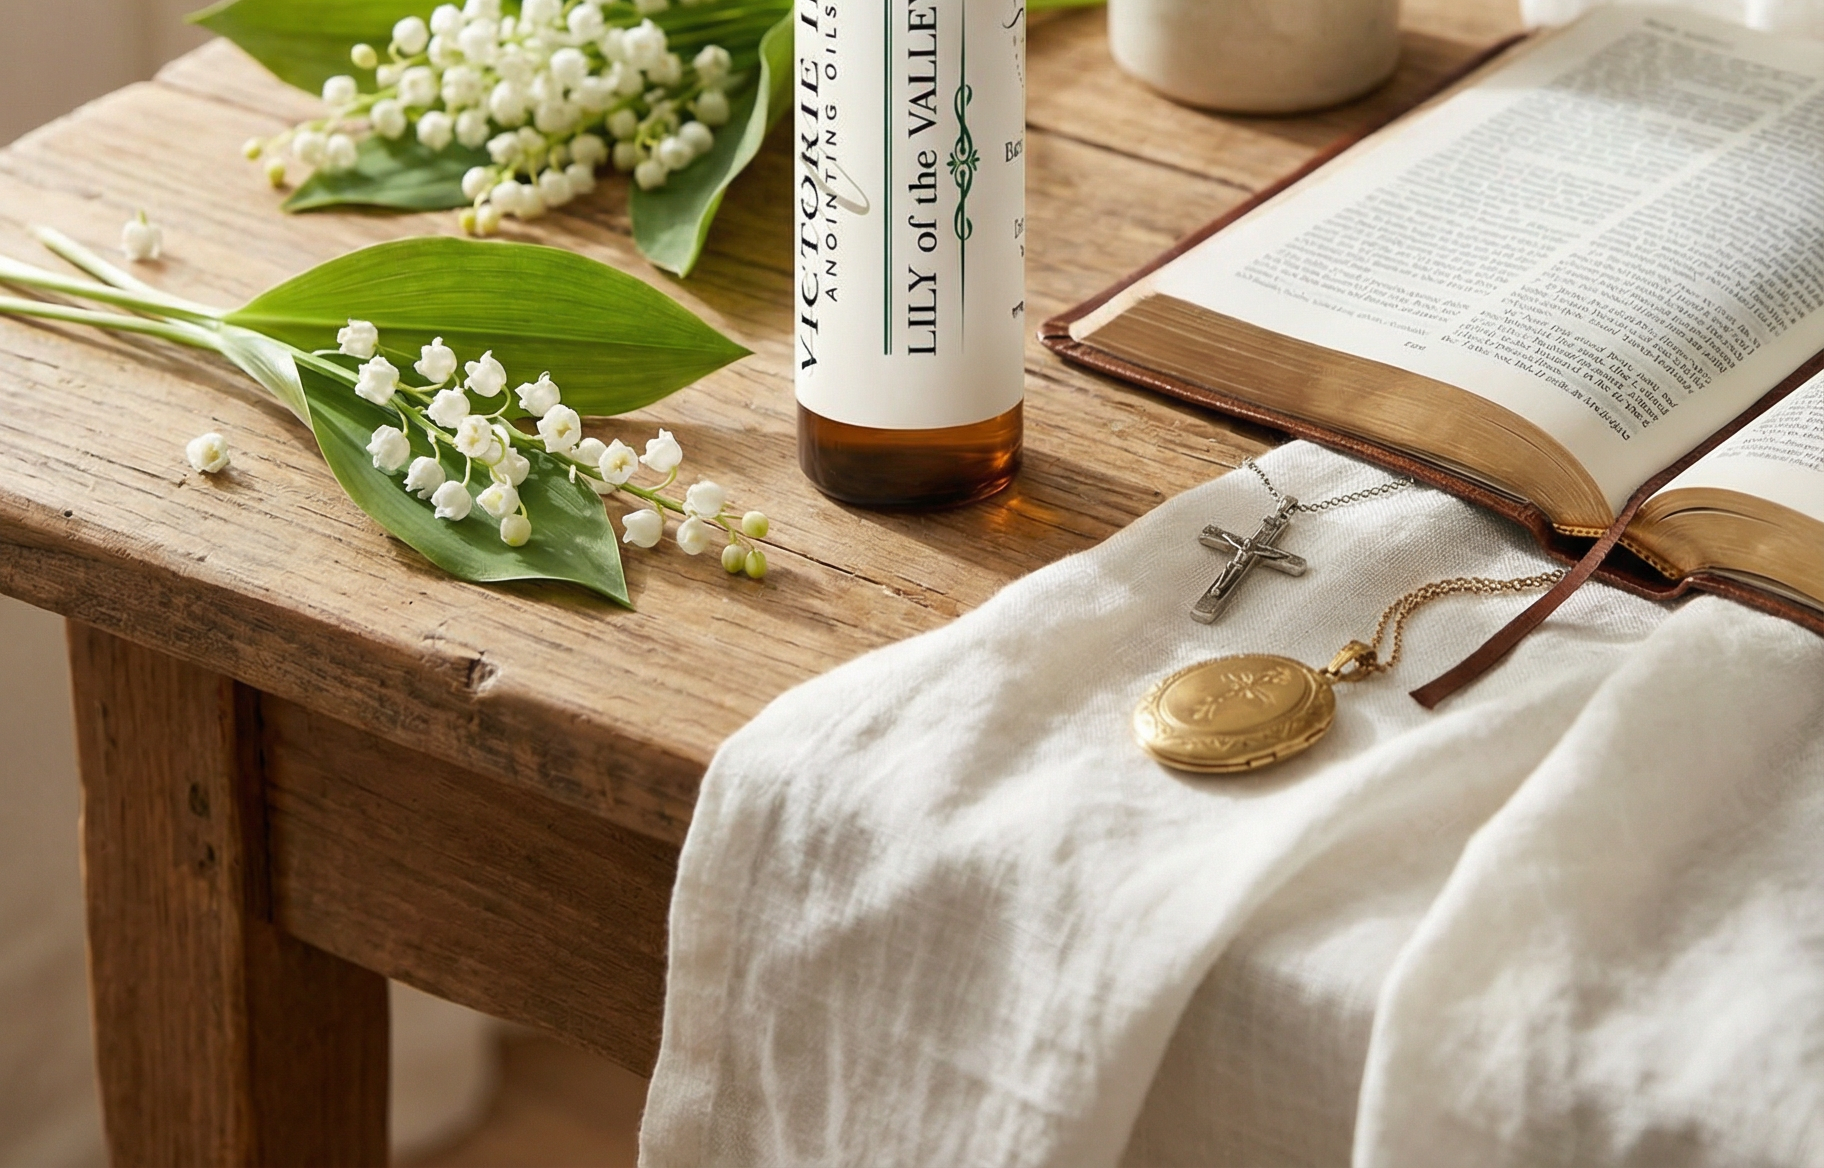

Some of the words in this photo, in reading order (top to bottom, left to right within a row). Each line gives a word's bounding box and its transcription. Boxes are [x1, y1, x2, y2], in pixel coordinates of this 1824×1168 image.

[824, 6, 838, 81] OILS
[824, 105, 838, 303] ANOINTING
[907, 149, 938, 206] the
[907, 214, 938, 253] of
[907, 265, 938, 356] LILY
